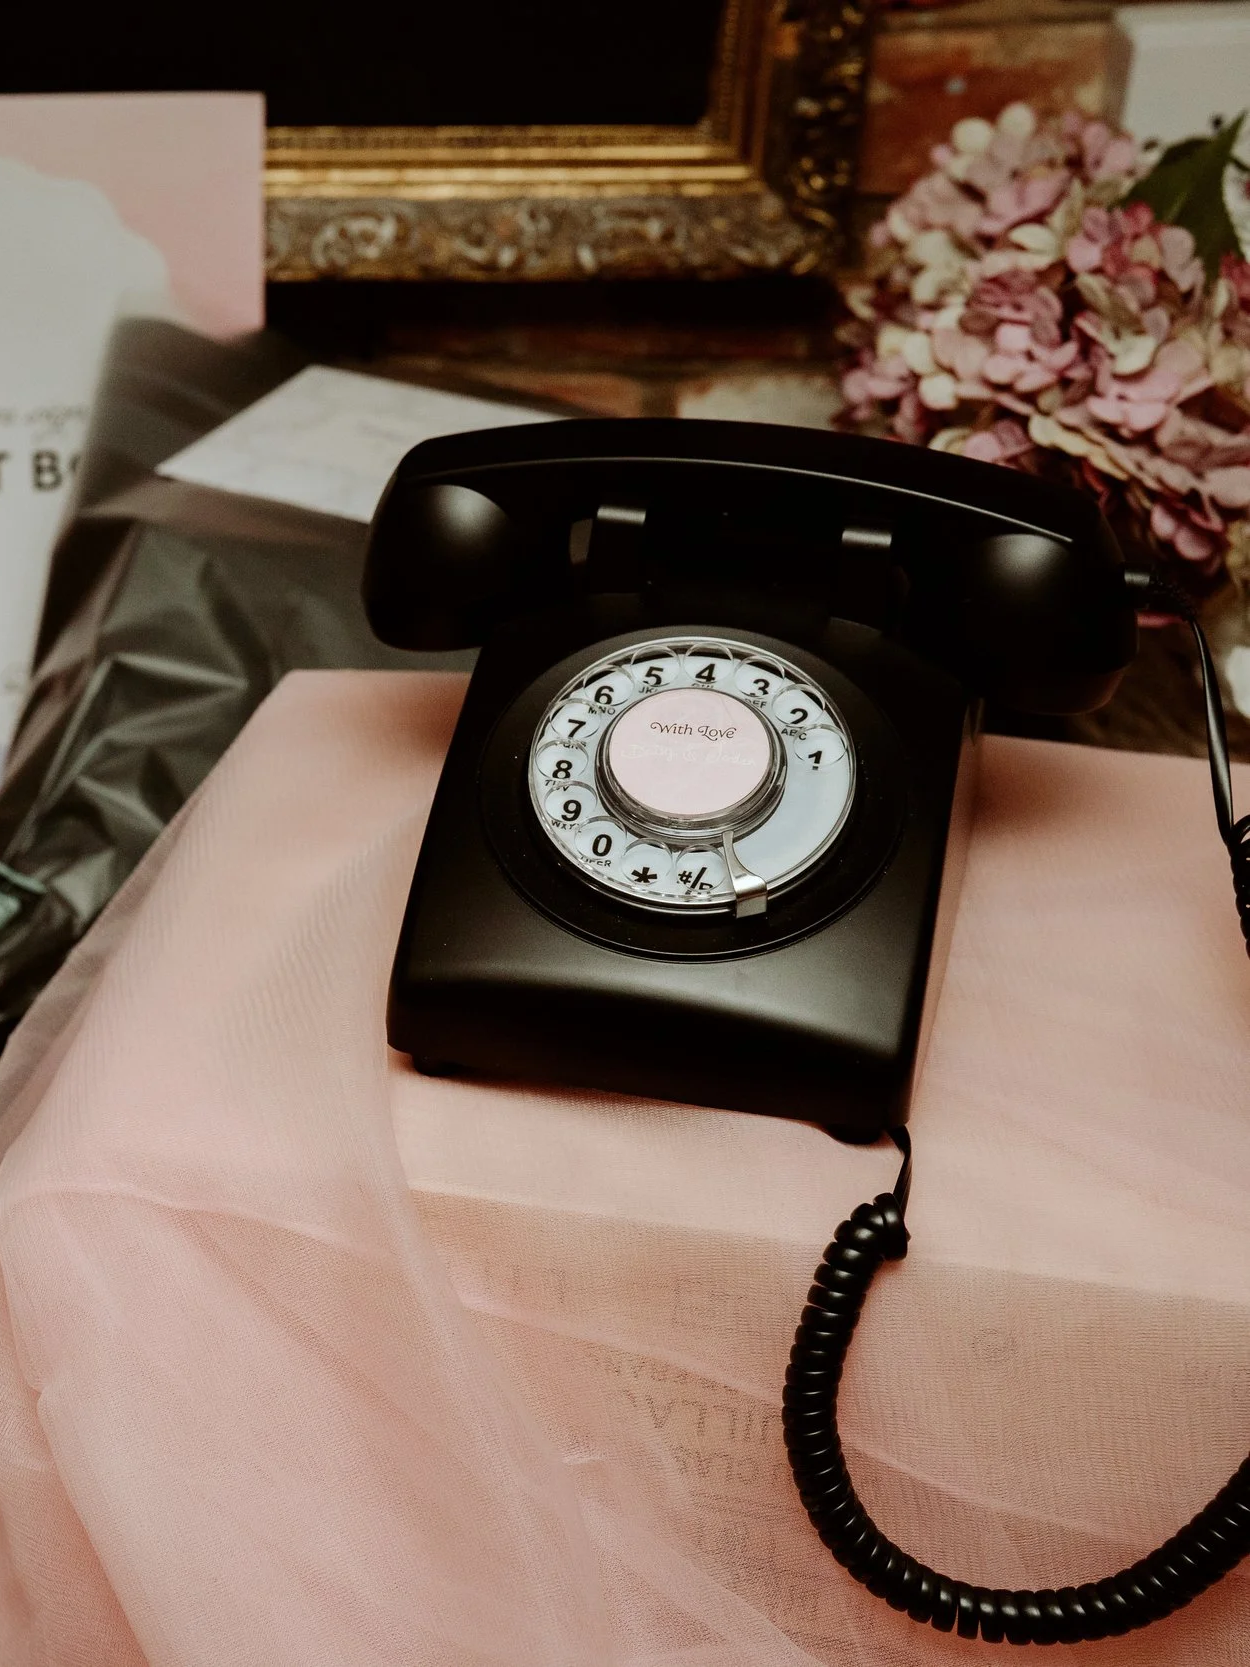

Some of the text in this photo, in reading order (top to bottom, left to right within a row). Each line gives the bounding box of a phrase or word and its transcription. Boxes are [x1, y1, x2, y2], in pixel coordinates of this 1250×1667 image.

[644, 666, 665, 687] 5
[695, 663, 716, 683] 4
[594, 685, 615, 705] 6
[751, 678, 770, 696] 3
[790, 708, 809, 728] 2
[568, 719, 586, 738] 7
[650, 721, 737, 742] With Love
[552, 760, 573, 779] 8
[808, 750, 823, 770] 1
[561, 799, 582, 822] 9
[592, 833, 613, 857] 0
